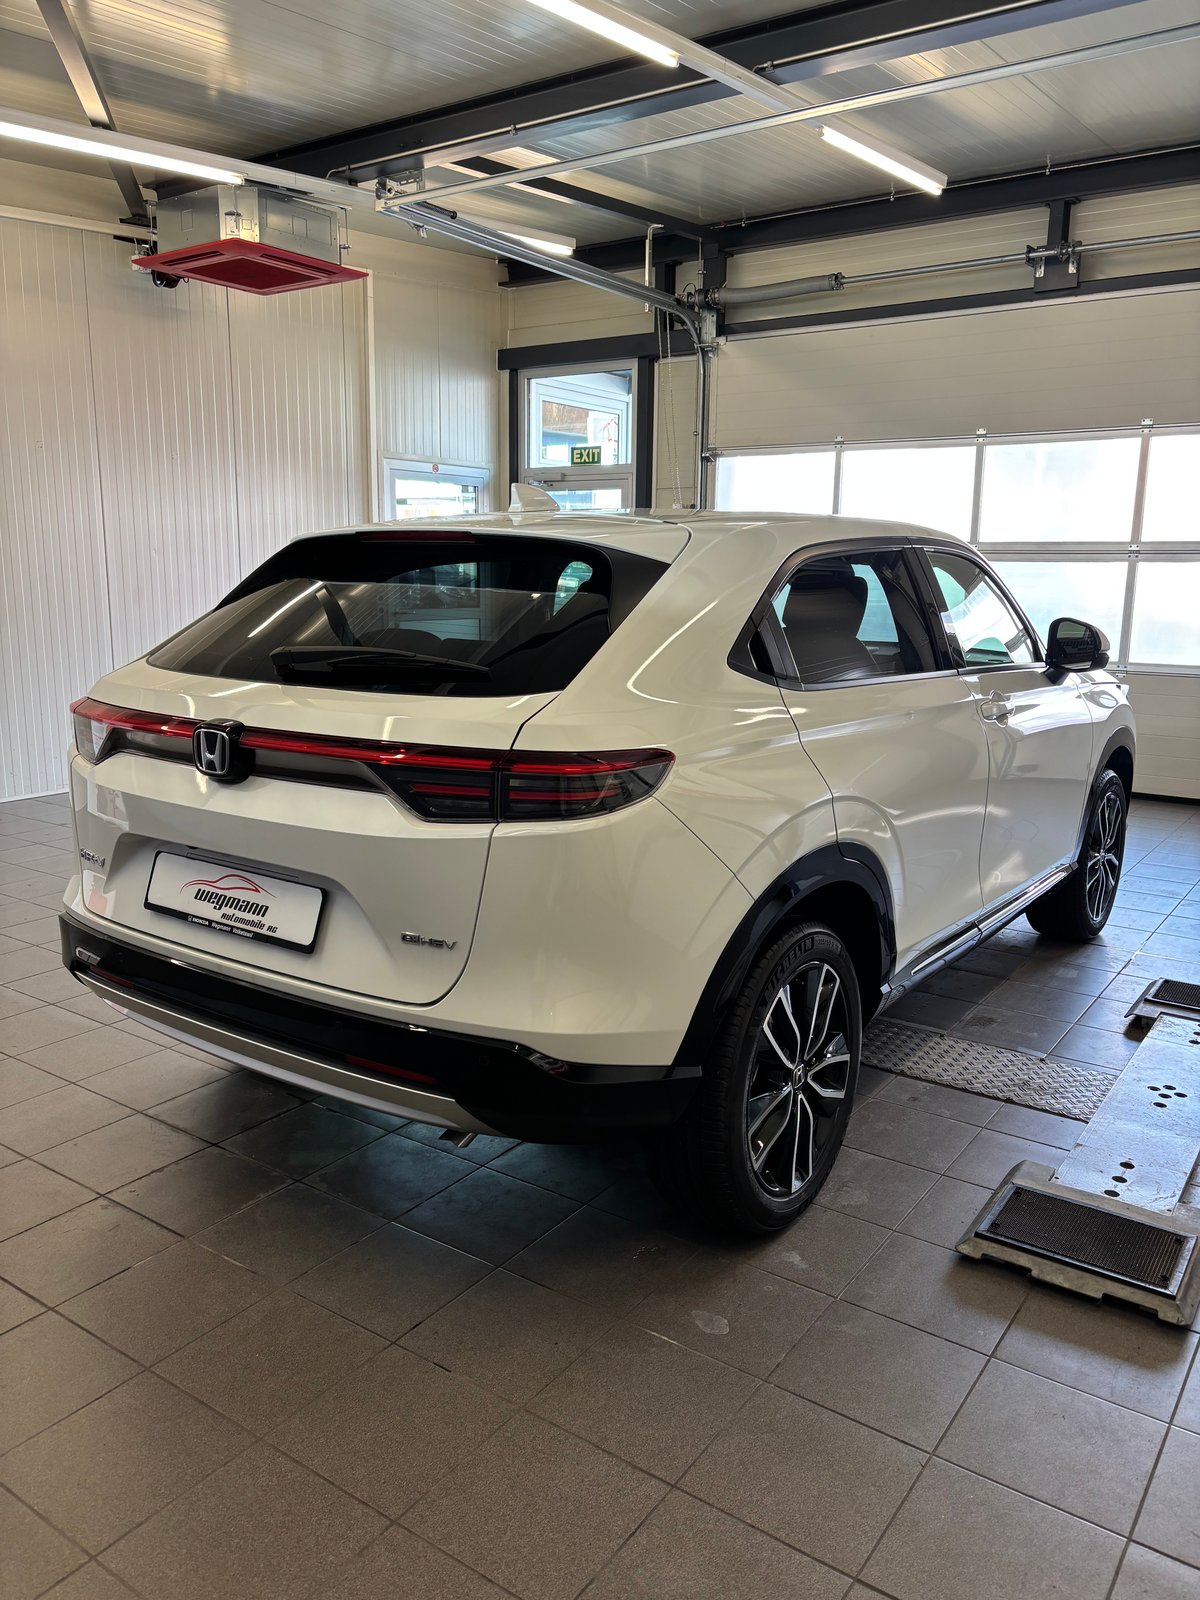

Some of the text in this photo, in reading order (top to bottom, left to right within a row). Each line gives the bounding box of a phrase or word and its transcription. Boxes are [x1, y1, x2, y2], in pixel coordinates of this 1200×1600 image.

[573, 448, 600, 463] EXIT
[194, 888, 269, 917] wegmann
[267, 925, 278, 933] AG
[761, 936, 815, 1004] MICHELIN
